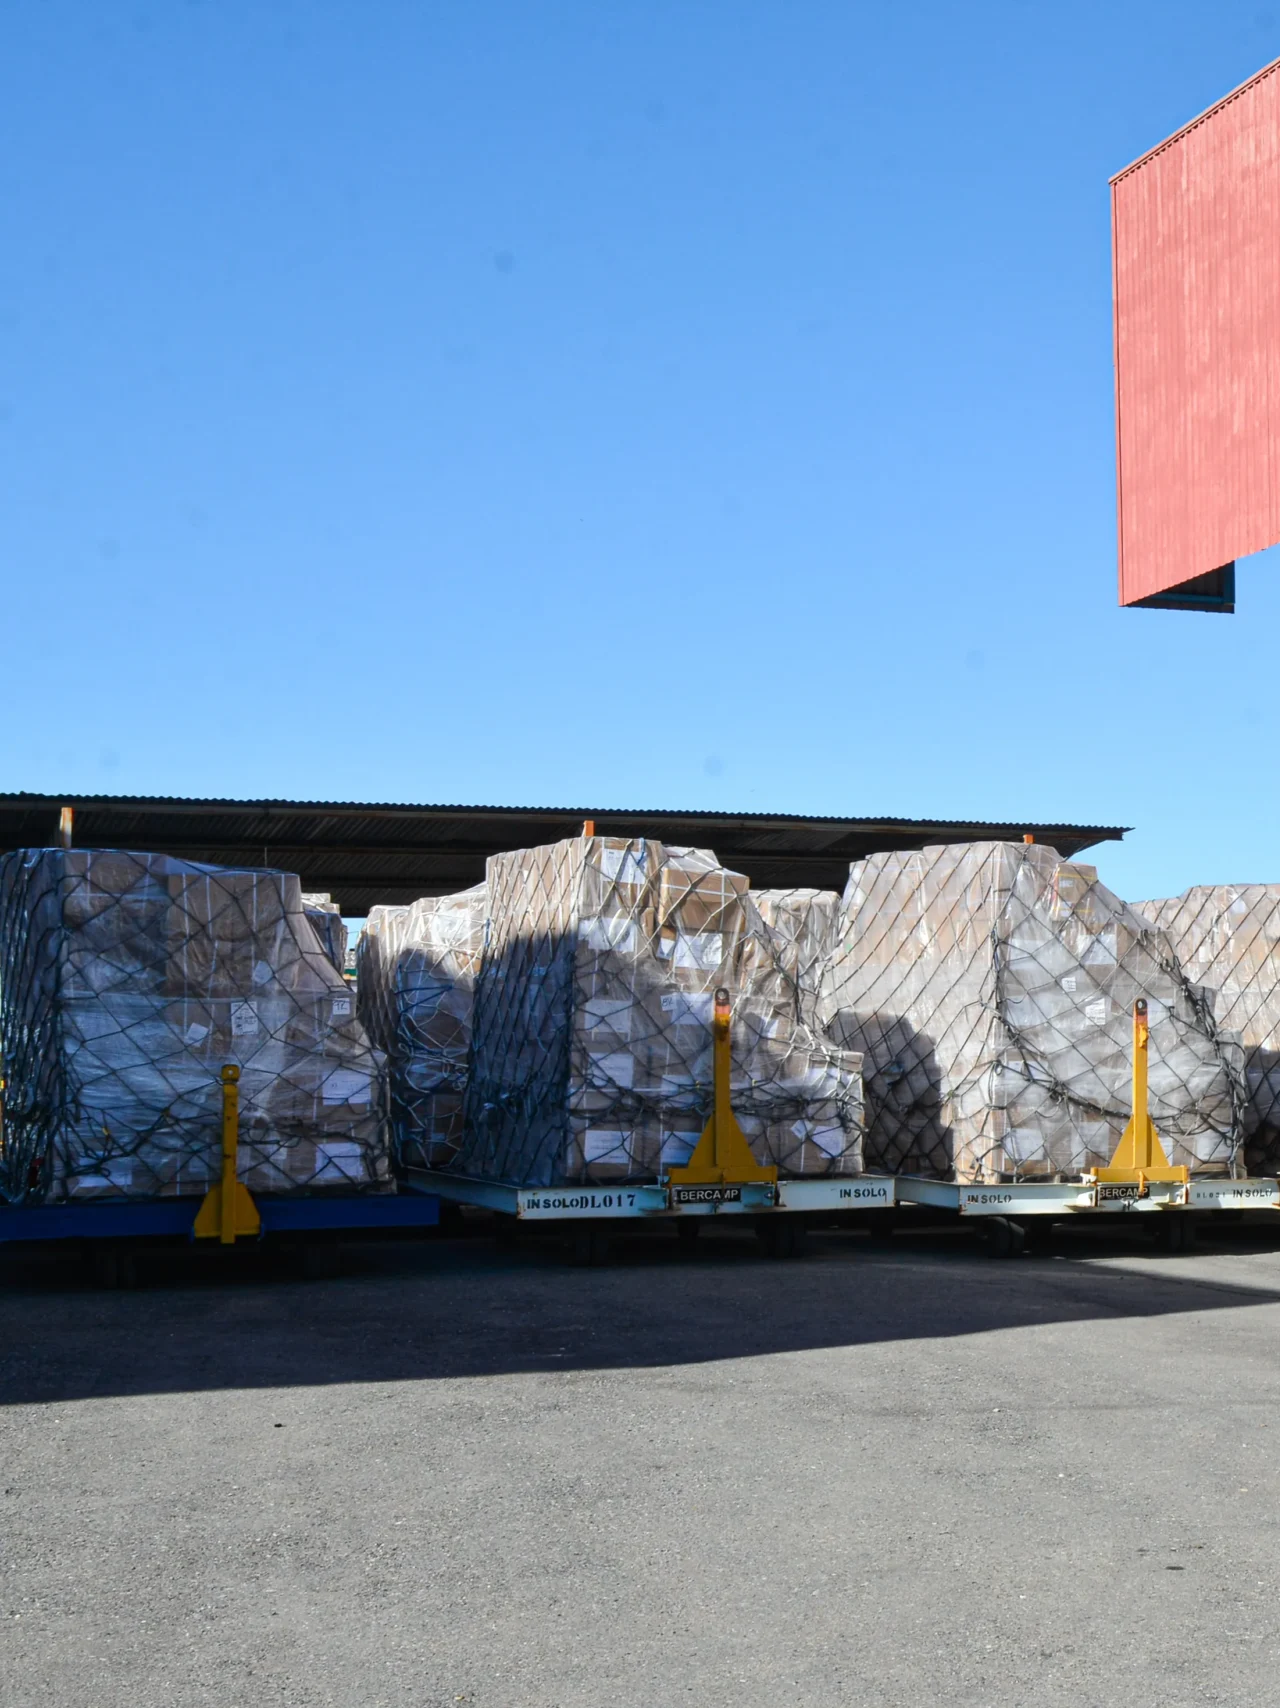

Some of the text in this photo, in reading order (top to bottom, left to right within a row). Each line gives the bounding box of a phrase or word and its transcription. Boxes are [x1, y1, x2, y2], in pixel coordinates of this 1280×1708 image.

[680, 1189, 739, 1201] BERCAMP
[839, 1187, 887, 1199] IN SOLO
[967, 1194, 1013, 1204] IN SOLO
[1232, 1188, 1273, 1198] IN SOLO
[527, 1198, 540, 1210] IN
